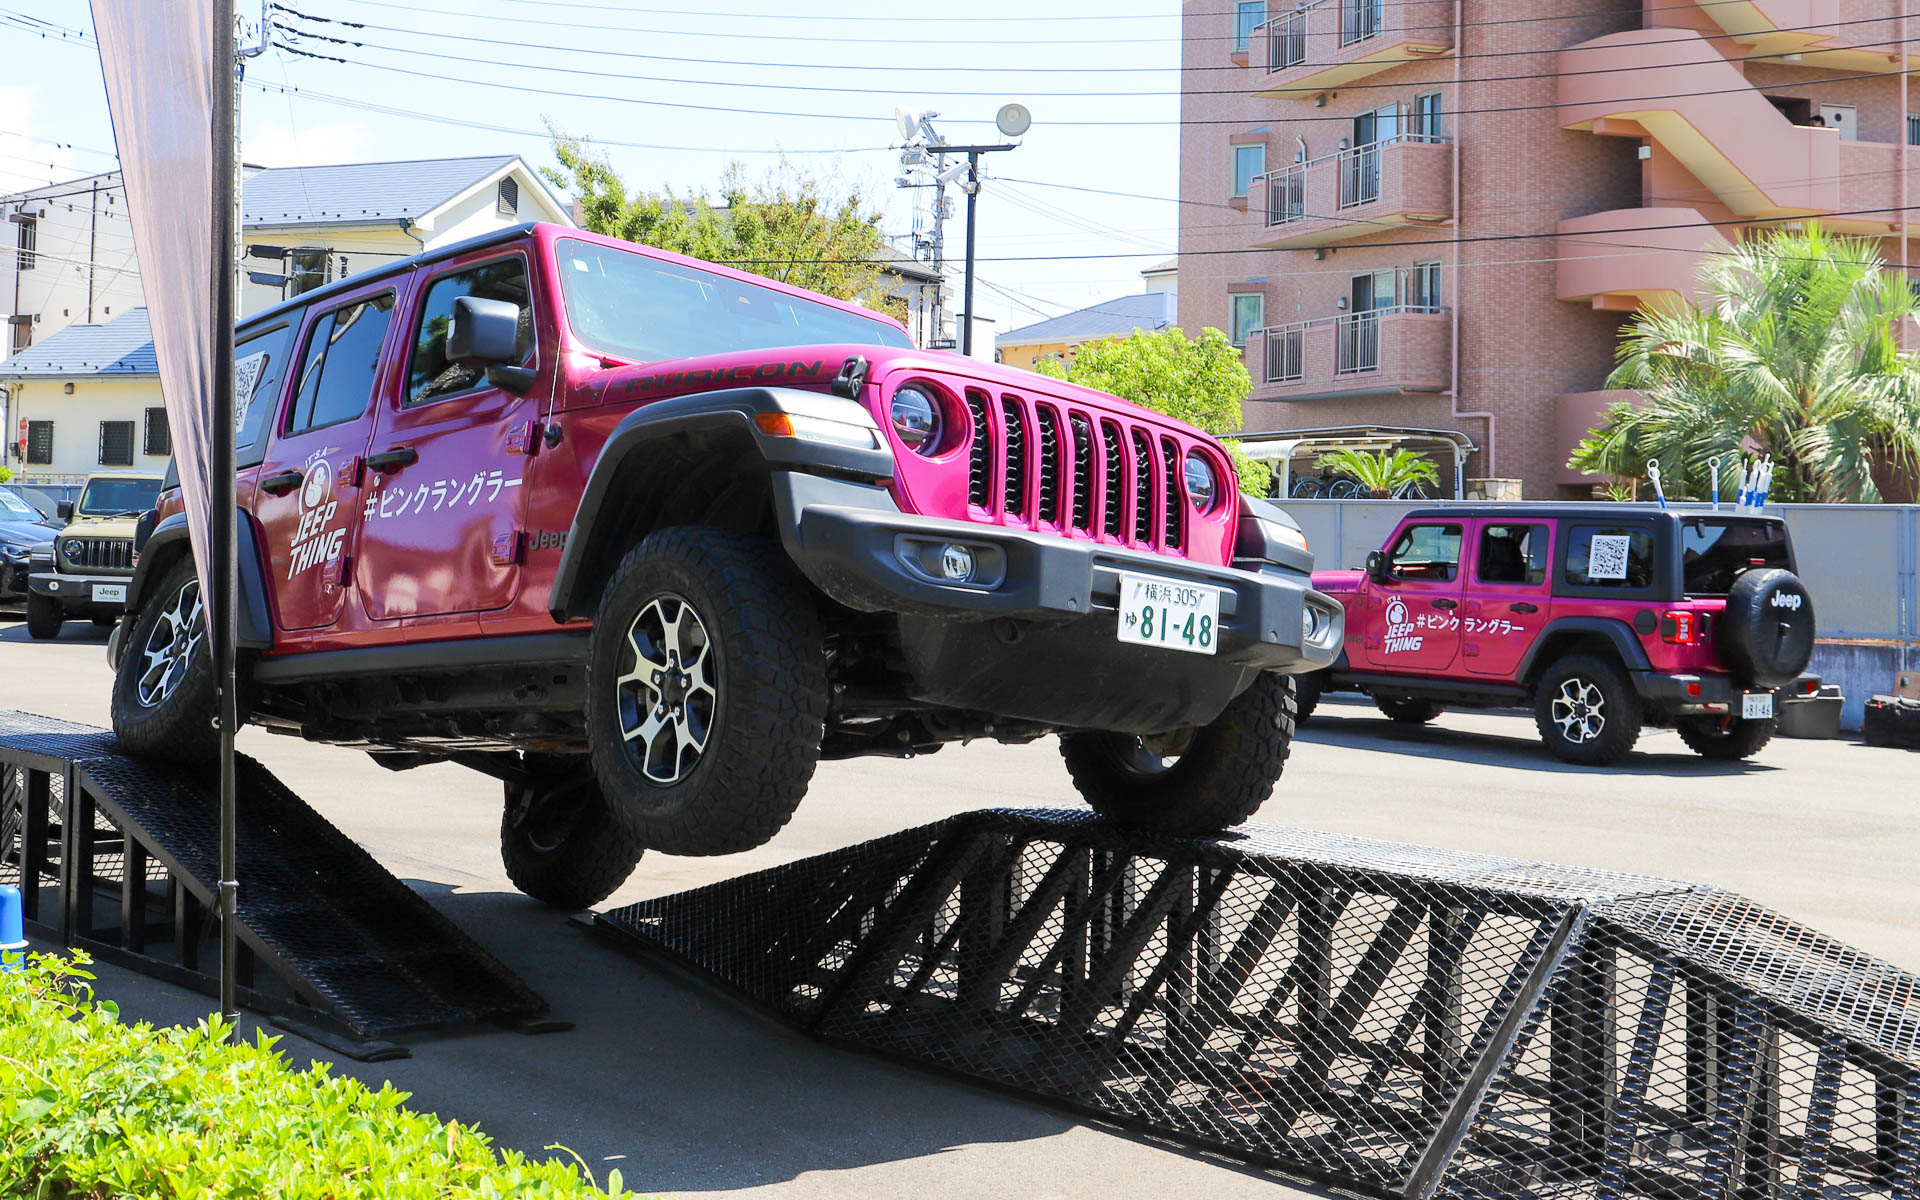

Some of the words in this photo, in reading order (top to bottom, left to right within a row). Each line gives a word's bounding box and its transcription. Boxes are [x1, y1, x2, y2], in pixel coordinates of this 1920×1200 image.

[626, 360, 824, 393] RUBICON
[305, 449, 320, 469] IT'S
[320, 446, 328, 457] A
[363, 470, 523, 522] #ピンクラングラー
[290, 501, 338, 547] JEEP
[529, 528, 570, 553] Jeep
[287, 527, 347, 580] THING
[99, 587, 120, 597] Jeep
[1771, 589, 1802, 611] Jeep
[1141, 605, 1212, 647] 81-48
[1384, 623, 1415, 640] JEEP
[1384, 637, 1424, 654] THING
